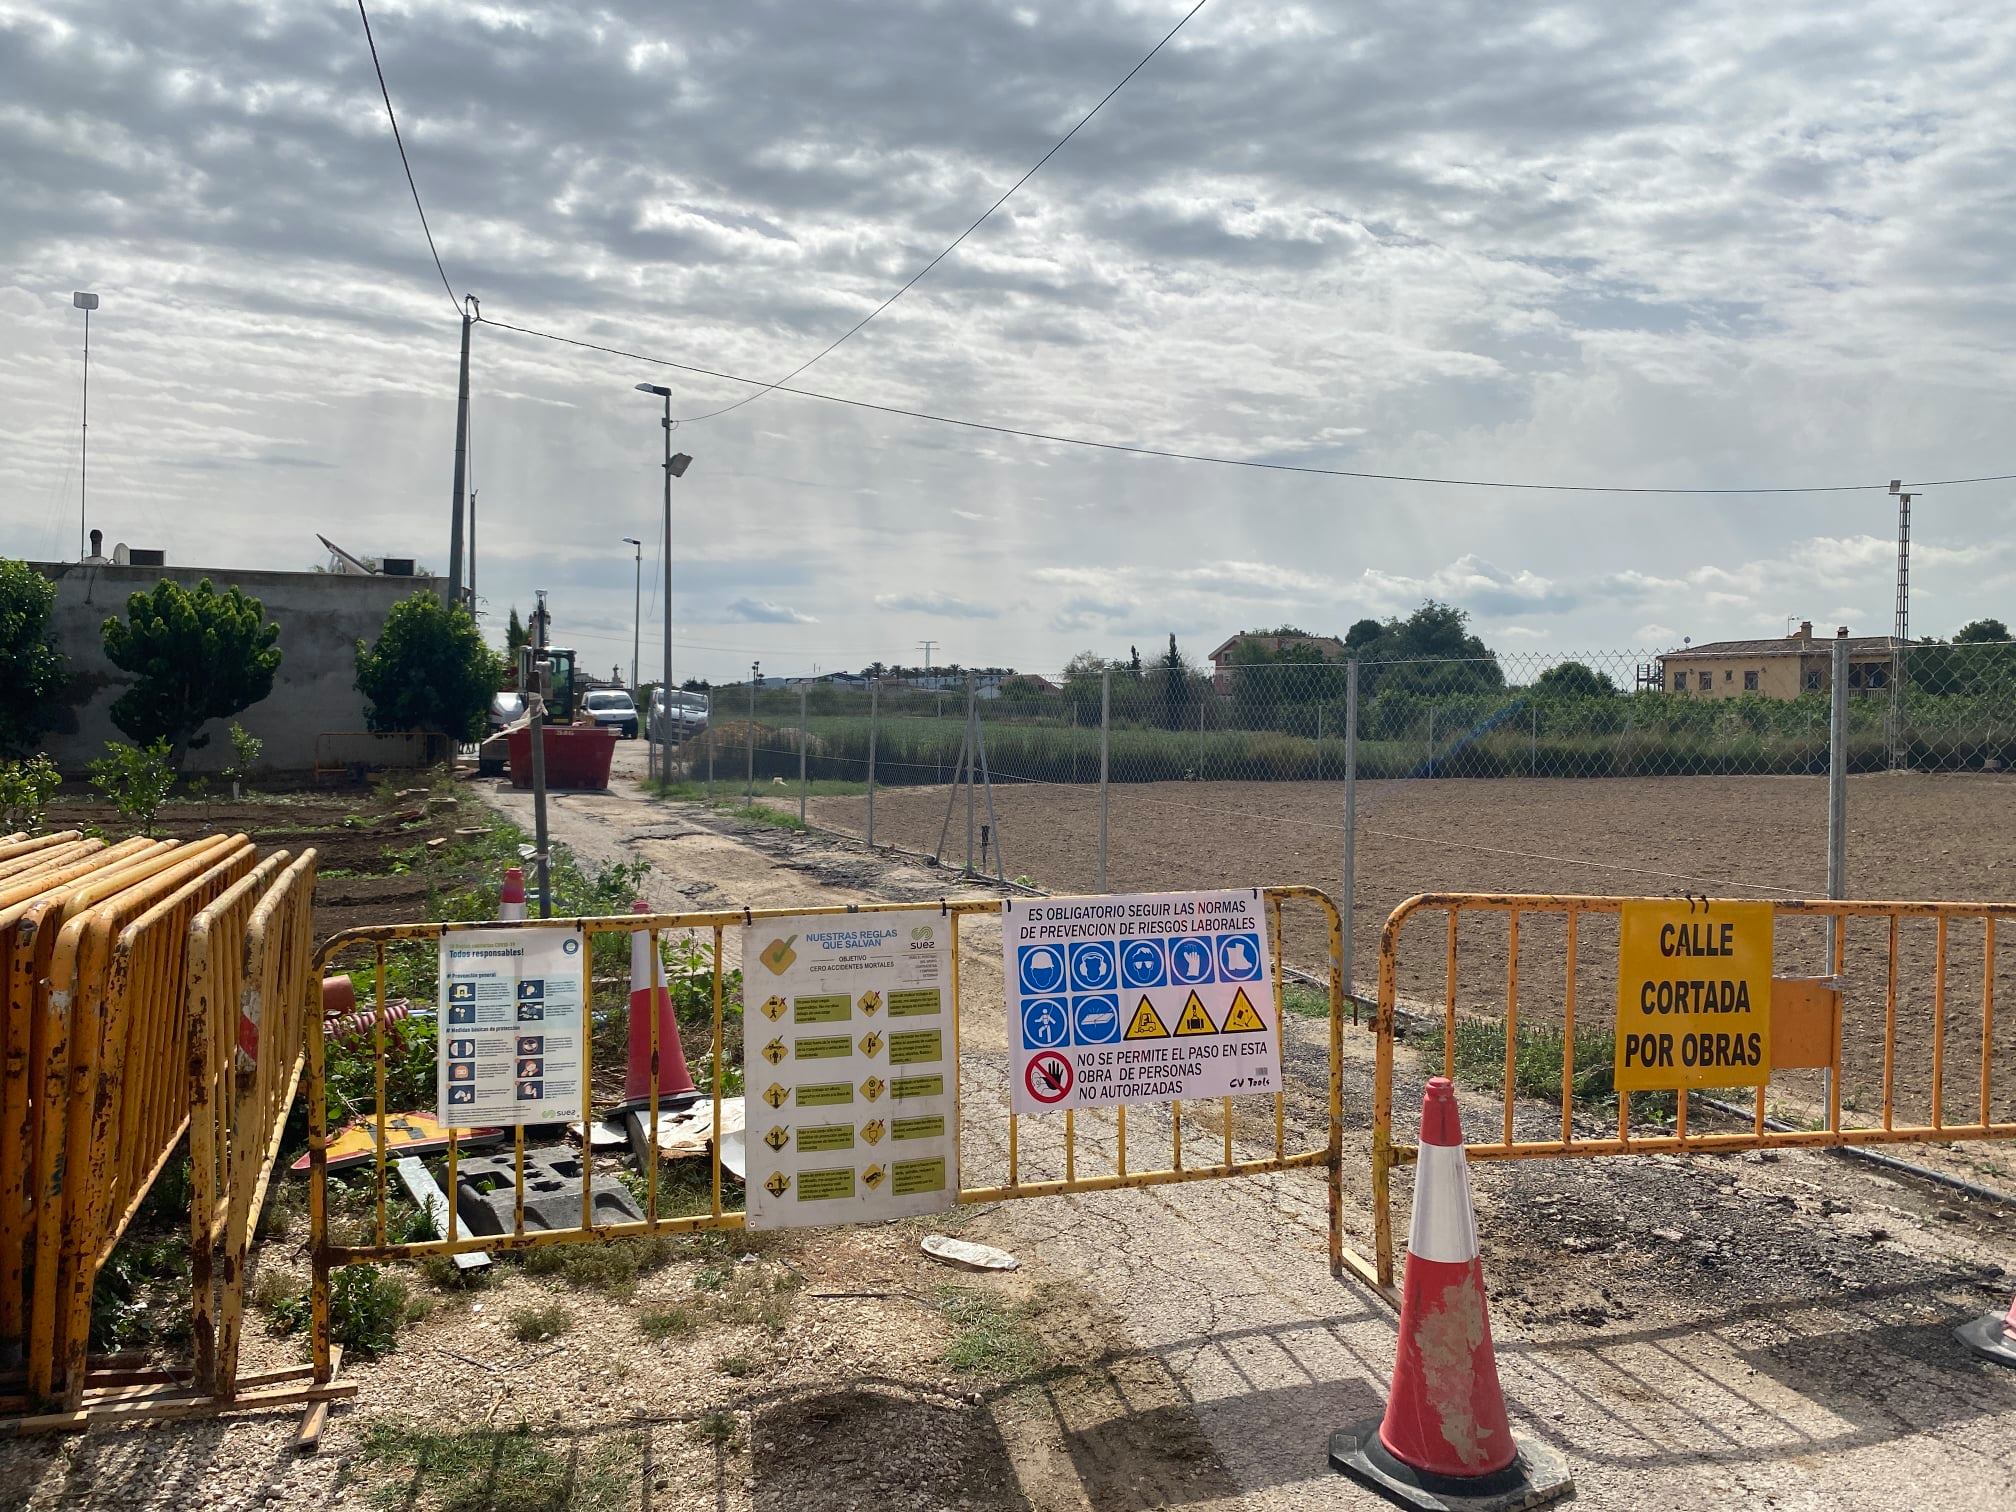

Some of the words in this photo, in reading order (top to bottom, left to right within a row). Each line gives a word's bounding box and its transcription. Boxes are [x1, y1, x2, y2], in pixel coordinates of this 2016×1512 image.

[1029, 908, 1042, 921] ES
[1047, 905, 1125, 920] OBLIGATORIO
[1128, 903, 1170, 918] SEGUIR
[1174, 902, 1194, 915] LAS
[1197, 900, 1246, 914] NORMAS
[806, 931, 858, 942] NUESTRAS
[860, 929, 898, 939] REGLAS
[1020, 926, 1036, 939] DE
[1040, 923, 1116, 938] PREVENCION
[1119, 922, 1134, 935] DE
[1138, 919, 1188, 934] RIESGOS
[1191, 916, 1256, 931] LABORALES
[822, 941, 843, 950] QUE
[845, 939, 881, 949] SALVAN
[910, 941, 935, 949] suez
[1660, 923, 1734, 957] CALLE
[449, 949, 471, 958] Todos
[472, 946, 524, 958] responsables!
[827, 963, 863, 971] ACCIDENTES
[864, 961, 894, 969] MORTALES
[1641, 980, 1751, 1015] CORTADA
[1077, 1053, 1094, 1066] NO
[1098, 1052, 1113, 1065] SE
[1117, 1049, 1168, 1064] PERMITE
[1171, 1047, 1185, 1061] EL
[1189, 1044, 1219, 1059] PASO
[1223, 1044, 1238, 1057] EN
[1241, 1041, 1267, 1055] ESTA
[1625, 1033, 1674, 1067] POR
[1682, 1033, 1761, 1067] OBRAS
[1078, 1068, 1112, 1083] OBRA
[1119, 1068, 1134, 1080] DE
[1138, 1062, 1202, 1079] PERSONAS
[1229, 1078, 1244, 1088] CV
[1247, 1077, 1270, 1087] Tools
[1079, 1086, 1096, 1100] NO
[1100, 1080, 1183, 1099] AUTORIZADAS
[556, 1109, 576, 1117] suez
